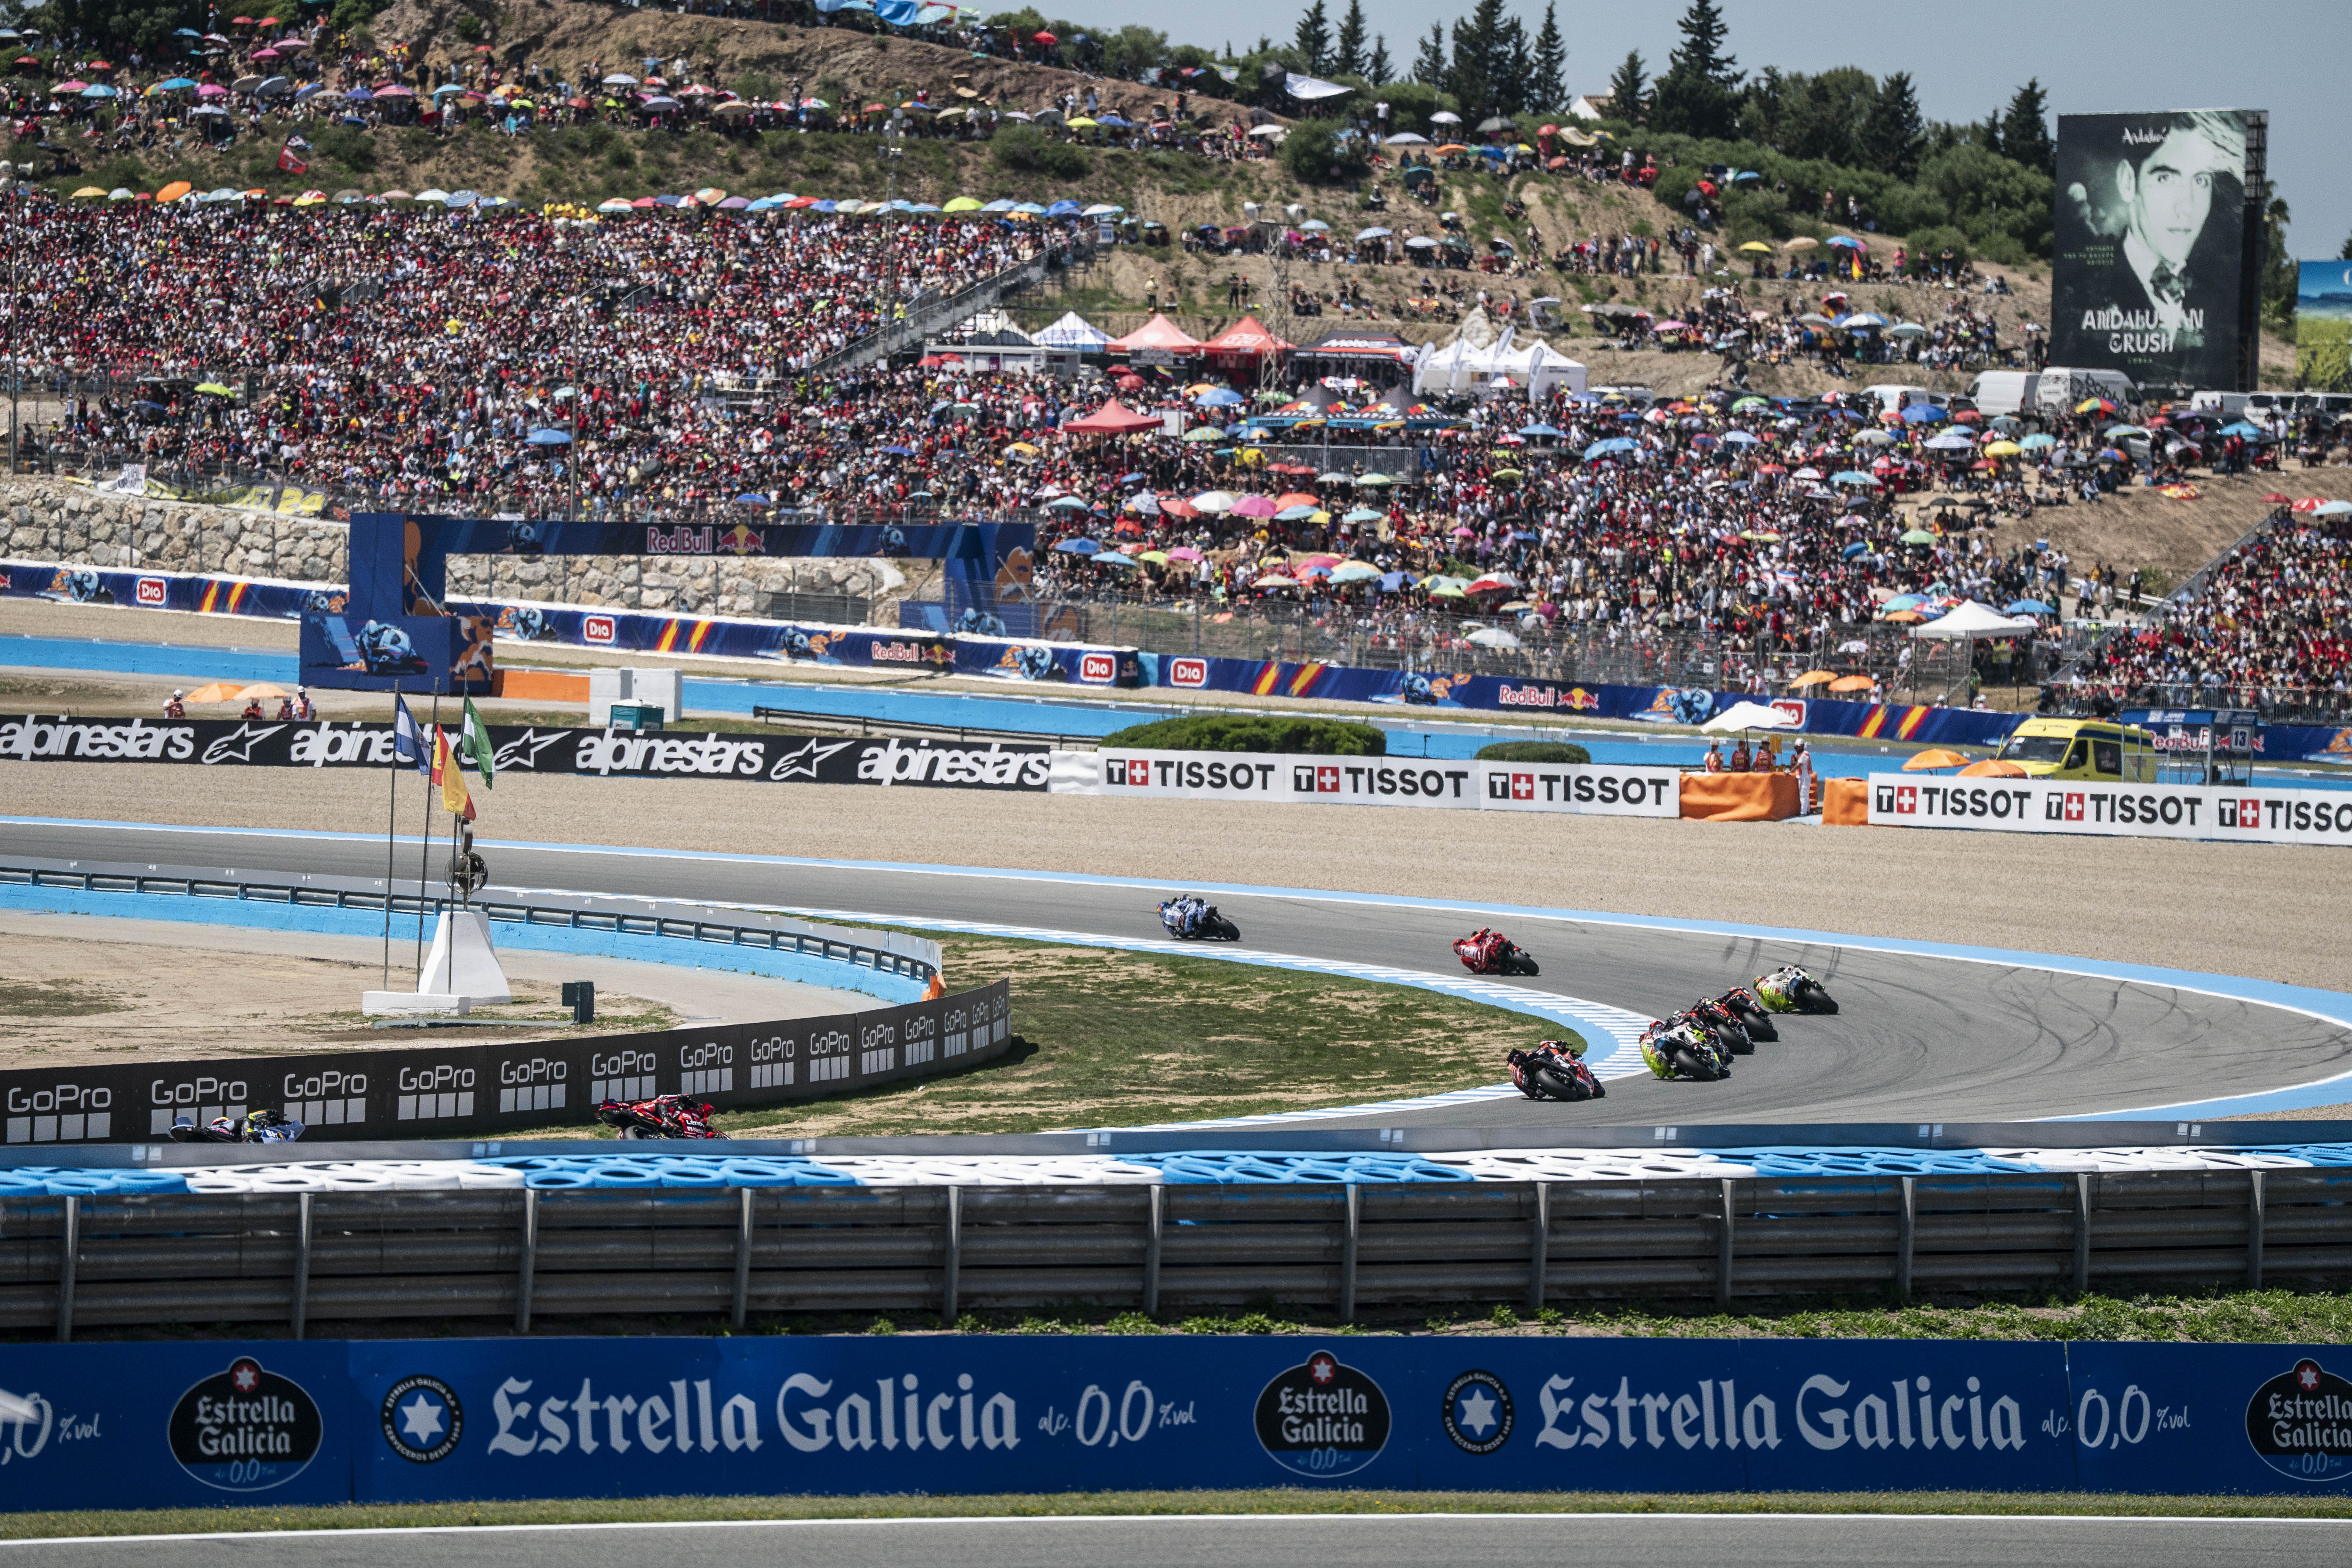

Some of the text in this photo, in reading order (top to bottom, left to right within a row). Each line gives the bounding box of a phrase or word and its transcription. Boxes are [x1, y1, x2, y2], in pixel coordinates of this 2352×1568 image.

[2109, 332, 2174, 353] CRUSH
[0, 714, 194, 761] alpinestars
[2201, 729, 2209, 742] F
[2234, 731, 2247, 747] 13
[576, 729, 764, 775] alpinestars
[857, 739, 1049, 785] alpinestars
[1154, 760, 1275, 790] TISSOT
[1345, 767, 1468, 798] TISSOT
[1539, 774, 1669, 805] TISSOT
[1922, 787, 2031, 819] TISSOT
[2090, 793, 2202, 826] TISSOT
[944, 1009, 967, 1033] GoPro
[972, 1002, 989, 1025] GoPro
[862, 1024, 894, 1048] GoPro
[905, 1016, 935, 1040] GoPro
[681, 1042, 733, 1068] GoPro
[751, 1036, 795, 1061] GoPro
[810, 1031, 849, 1055] GoPro
[501, 1058, 567, 1083] GoPro
[592, 1050, 656, 1076] GoPro
[151, 1077, 247, 1104] GoPro
[284, 1071, 367, 1097] GoPro
[399, 1065, 475, 1091] GoPro
[8, 1084, 111, 1112] GoPro
[195, 1395, 295, 1424] Estrella
[1278, 1387, 1368, 1414] Estrella
[1535, 1374, 1782, 1450] Estrella
[1796, 1374, 2026, 1451] Galicia
[2078, 1385, 2150, 1449] 0,0
[2268, 1393, 2352, 1419] Estrella
[488, 1377, 763, 1456] Estrella
[777, 1372, 1020, 1452] Galicia
[1076, 1380, 1154, 1448] 0,0
[198, 1425, 291, 1456] Galicia
[1282, 1415, 1364, 1443] Galicia
[2272, 1420, 2352, 1448] Galicia
[229, 1458, 261, 1483] 0,0
[1310, 1446, 1338, 1470] 0,0
[2302, 1451, 2328, 1474] 0,0
